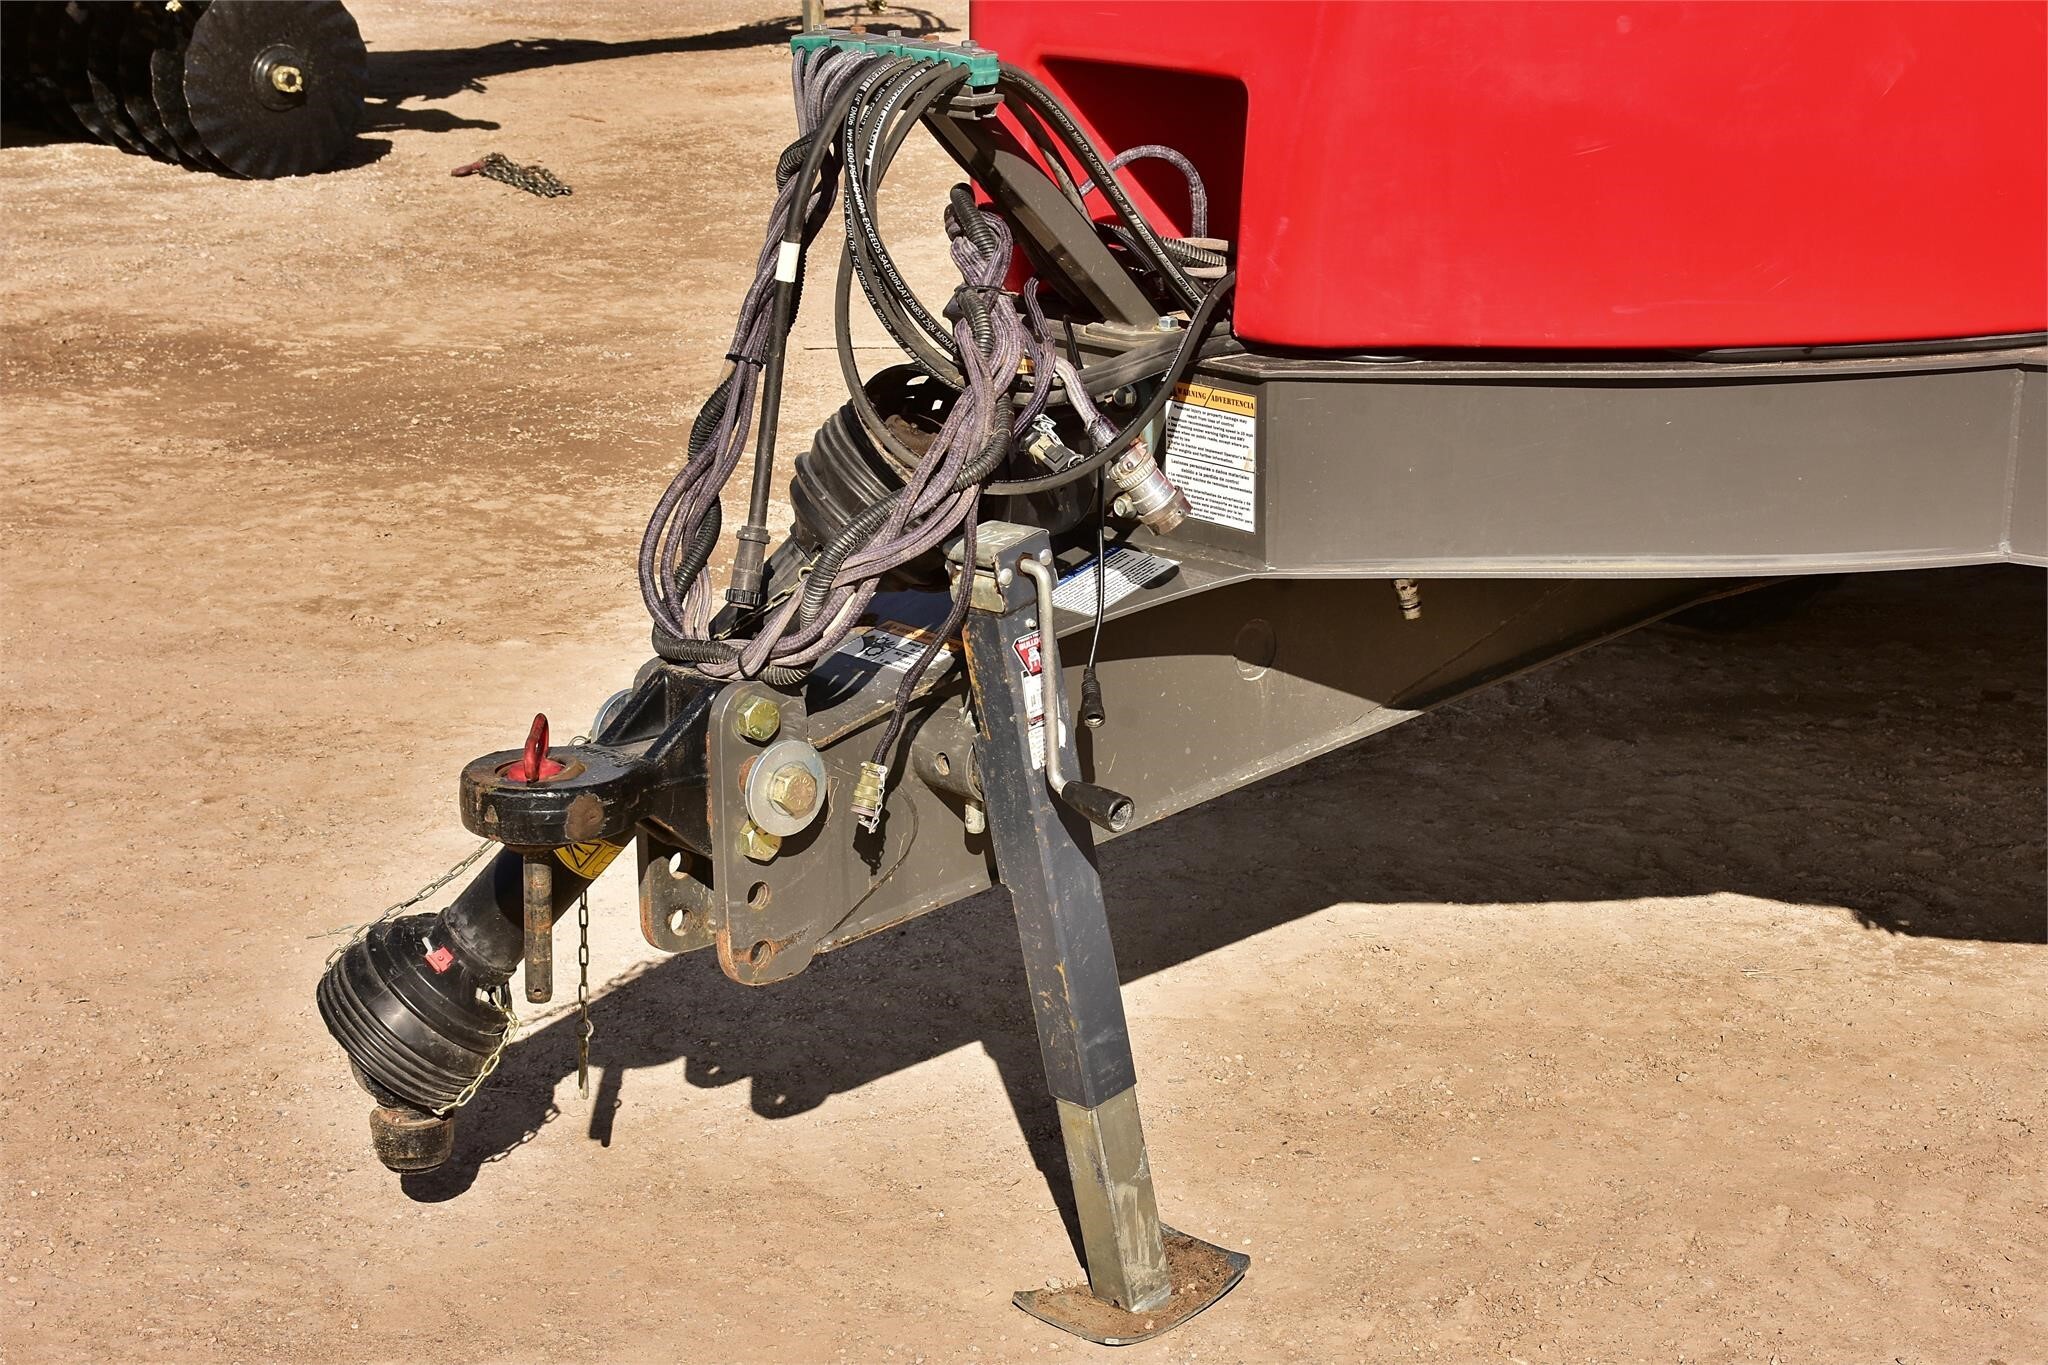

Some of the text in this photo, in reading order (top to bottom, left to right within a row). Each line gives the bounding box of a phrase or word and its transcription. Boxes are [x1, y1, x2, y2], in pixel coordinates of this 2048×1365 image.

[848, 106, 858, 126] DN06
[846, 128, 854, 142] WP
[846, 142, 855, 166] 5800
[848, 164, 858, 180] PSI
[855, 192, 866, 214] MPA
[846, 218, 854, 240] MPA
[862, 217, 883, 254] EXCEEDS
[935, 330, 952, 350] MSHA
